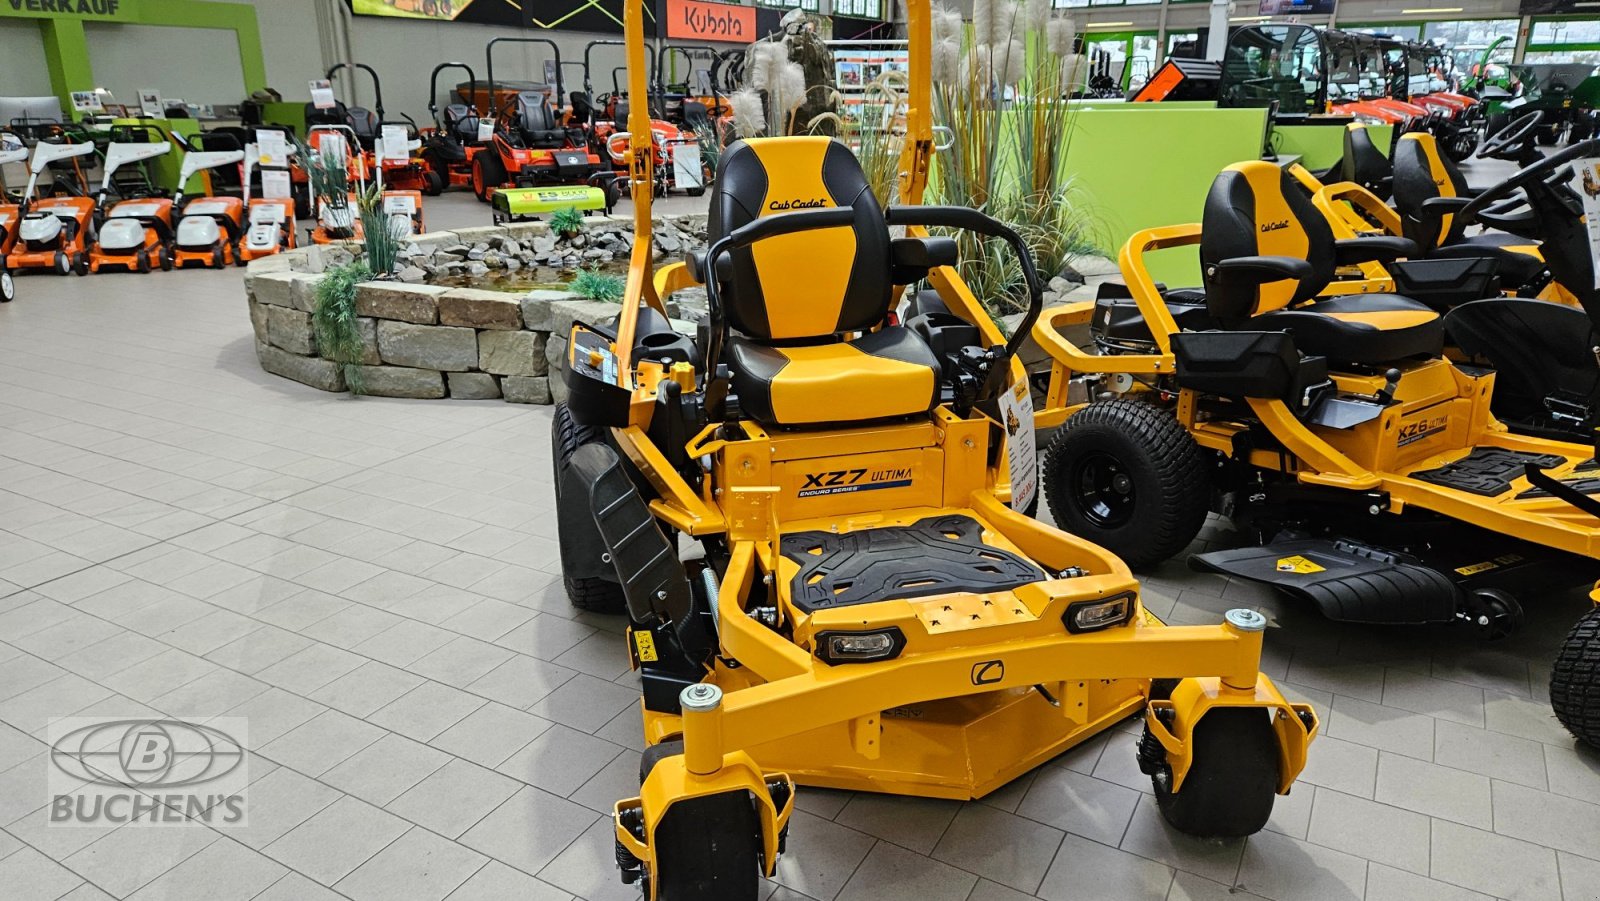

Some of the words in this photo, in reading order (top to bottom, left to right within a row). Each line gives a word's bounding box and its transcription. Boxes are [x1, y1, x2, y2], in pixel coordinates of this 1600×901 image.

[9, 0, 119, 15] VERKAUF
[685, 6, 741, 36] Kubota
[769, 201, 790, 210] Cub
[791, 198, 826, 209] Cadet
[1397, 419, 1428, 440] XZ6
[801, 468, 868, 489] XZ7
[871, 468, 912, 482] ULTIMA
[799, 488, 831, 497] ENDURO
[832, 486, 858, 494] SERIES
